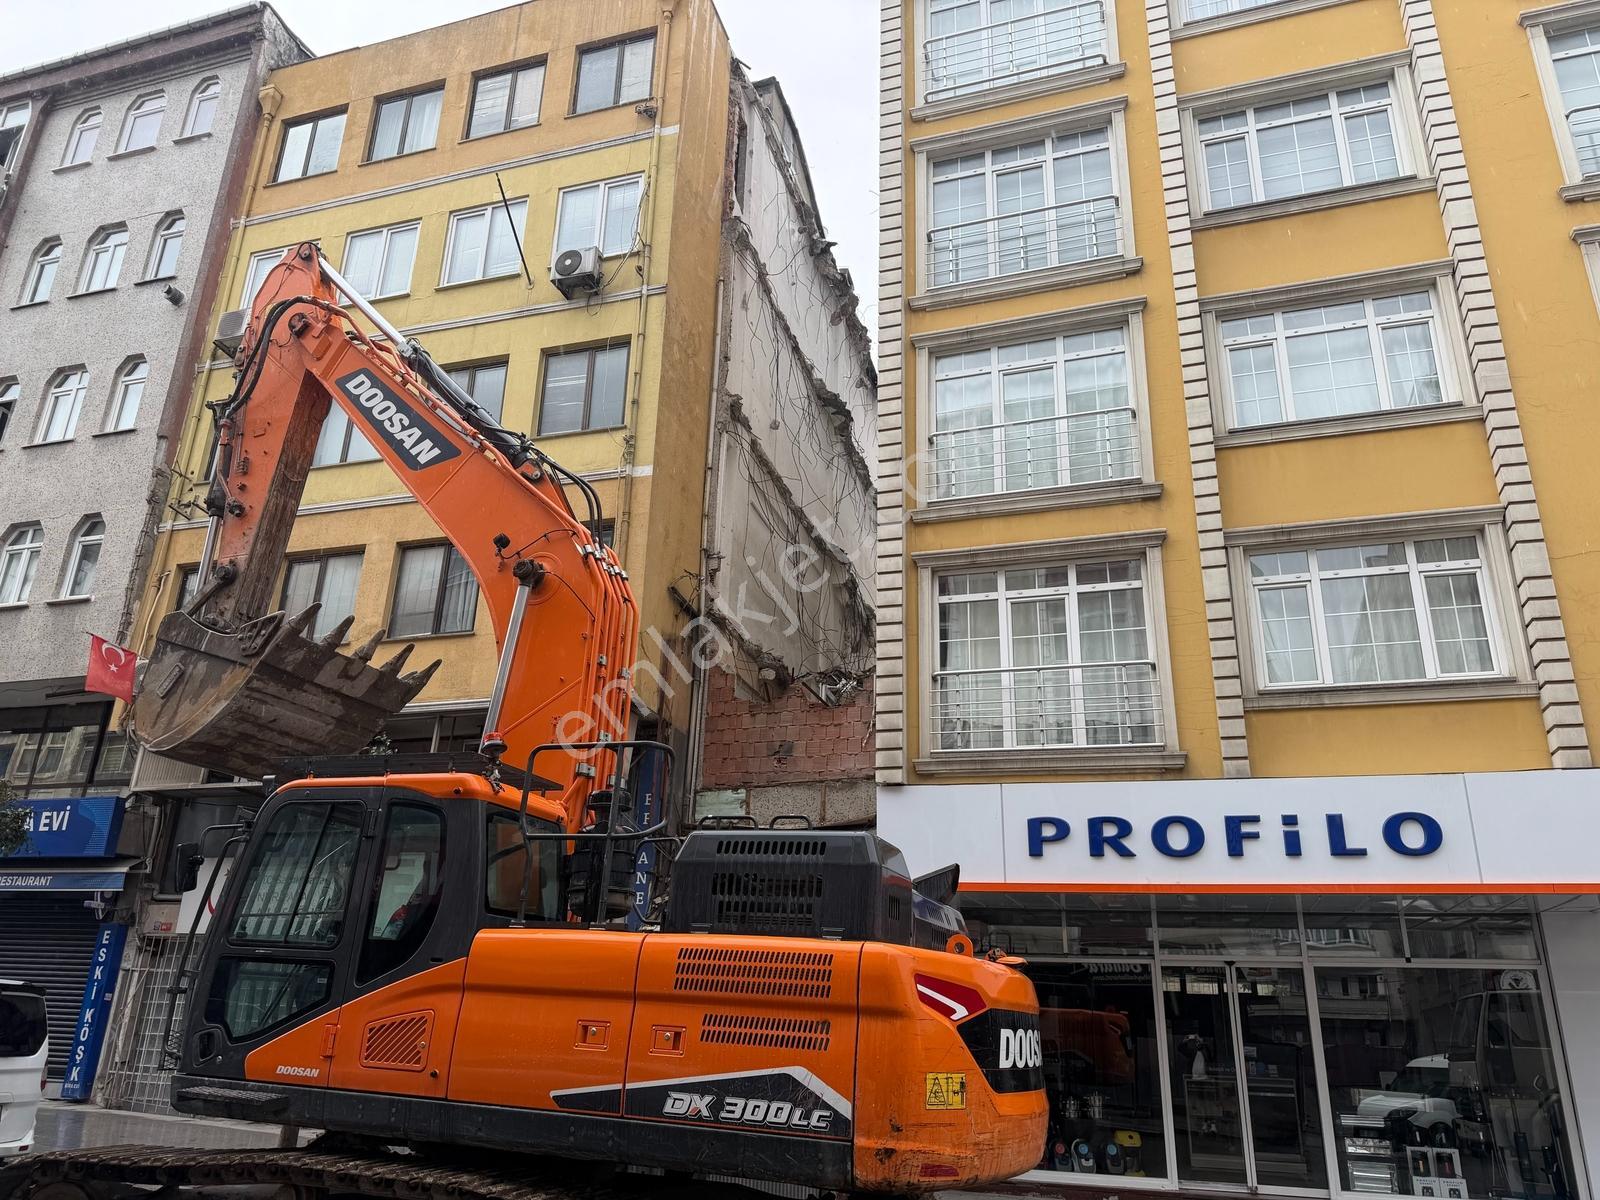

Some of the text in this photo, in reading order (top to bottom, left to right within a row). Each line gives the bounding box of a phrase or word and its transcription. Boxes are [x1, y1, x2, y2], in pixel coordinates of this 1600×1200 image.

[345, 373, 441, 464] DOOSAN
[38, 805, 71, 832] EVİ
[91, 930, 111, 1000] ESKİ
[70, 1008, 96, 1082] KÖŞK
[275, 1065, 320, 1078] DOOSAN
[662, 1090, 716, 1121] DX
